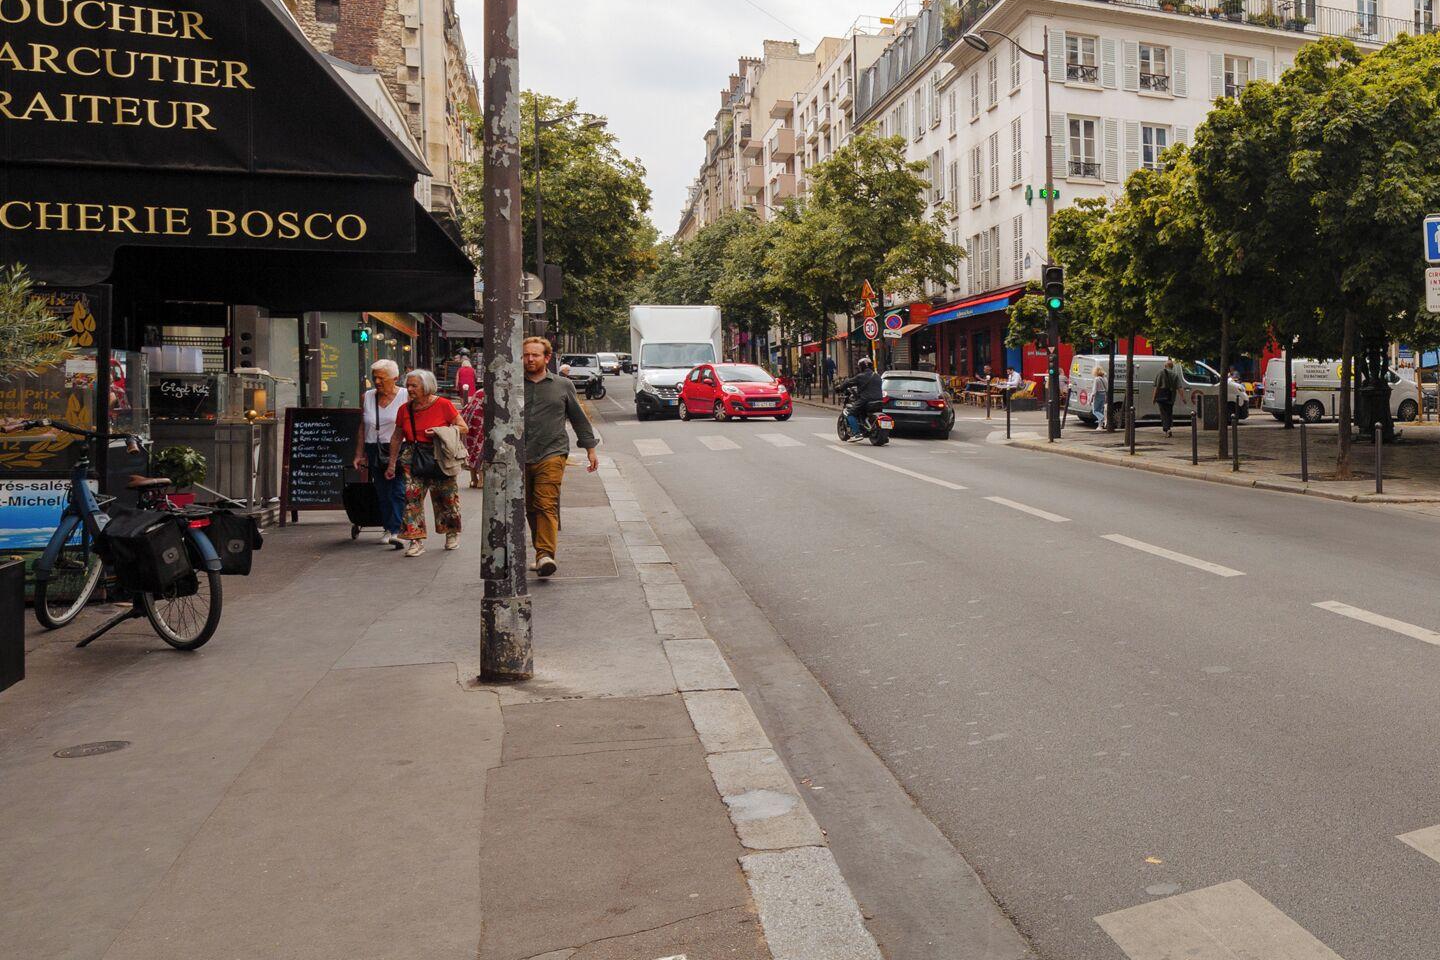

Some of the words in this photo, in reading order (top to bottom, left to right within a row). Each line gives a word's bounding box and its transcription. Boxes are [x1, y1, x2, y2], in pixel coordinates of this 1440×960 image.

[0, 201, 192, 235] CHERIE
[206, 208, 368, 241] BOSCO
[866, 324, 875, 333] 30
[25, 389, 60, 399] Prix
[161, 381, 190, 398] Gigot
